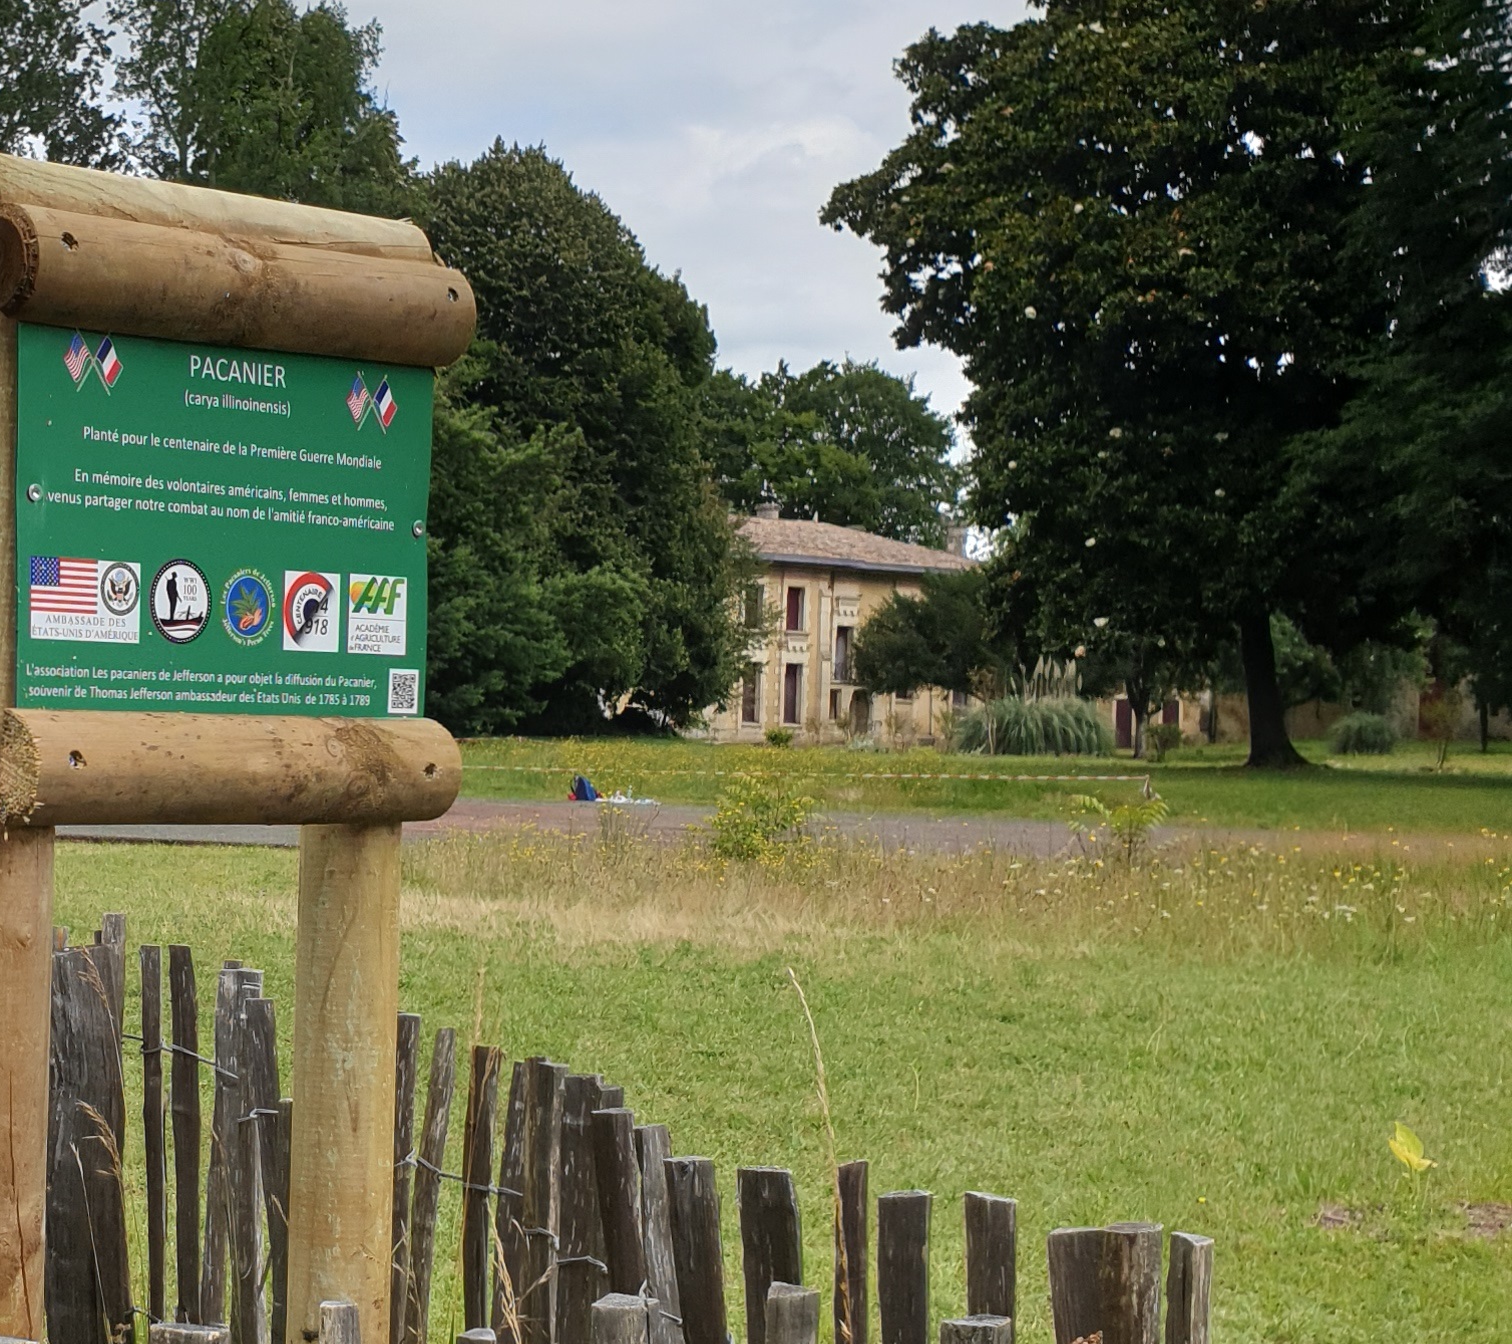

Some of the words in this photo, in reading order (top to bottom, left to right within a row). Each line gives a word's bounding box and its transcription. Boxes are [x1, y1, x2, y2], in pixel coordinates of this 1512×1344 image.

[190, 355, 287, 389] PACANIER
[185, 390, 218, 409] (carya
[223, 394, 291, 418] illinoinensis)
[84, 426, 118, 442] Planté
[122, 434, 147, 448] pour
[151, 434, 160, 446] le
[163, 438, 220, 452] centenaire
[223, 442, 235, 454] de
[239, 443, 247, 455] la
[251, 444, 296, 460] Première
[300, 449, 333, 464] Guerre
[337, 453, 381, 469] Mondiale
[75, 469, 88, 482] En
[92, 471, 142, 487] mémoire
[145, 475, 163, 489] des
[167, 479, 225, 495] volontaires
[229, 485, 286, 502] américains,
[289, 488, 328, 503] femmes
[332, 495, 341, 505] et
[344, 493, 387, 511] hommes,
[48, 492, 81, 504] venus
[85, 495, 132, 510] partager
[136, 499, 164, 511] notre
[168, 502, 207, 515] combat
[211, 506, 223, 516] au
[227, 508, 249, 518] nom
[253, 507, 265, 519] de
[269, 508, 305, 523] l'amitié
[308, 511, 394, 530] franco-américaine
[183, 584, 198, 595] 100
[352, 576, 405, 615] AAF
[296, 587, 323, 625] CENTENAIRE
[32, 625, 83, 638] ÉTATS-UNIS
[85, 629, 138, 641] D'AMÉRIQUE
[45, 615, 107, 627] AMBASSADE
[108, 618, 126, 628] DES
[355, 622, 390, 634] ACADÉMIE
[354, 643, 382, 653] FRANCE
[26, 664, 89, 677] L'association
[93, 667, 108, 678] Les
[111, 669, 156, 681] pacaniers
[159, 669, 170, 680] de
[173, 670, 214, 682] Jefferson
[217, 674, 222, 682] a
[225, 675, 247, 685] pour
[249, 673, 272, 686] objet
[275, 673, 282, 684] la
[285, 674, 322, 685] diffusion
[325, 676, 336, 686] du
[339, 676, 376, 688] Pacanier,
[29, 685, 72, 696] souvenir
[74, 686, 87, 697] de
[90, 686, 127, 698] Thomas
[130, 687, 172, 700] Jefferson
[175, 690, 237, 702] ambassadeur
[239, 691, 254, 703] des
[282, 693, 300, 704] Unis
[305, 694, 316, 704] de
[319, 694, 339, 705] 1785
[342, 694, 347, 705] à
[350, 695, 370, 705] 1789
